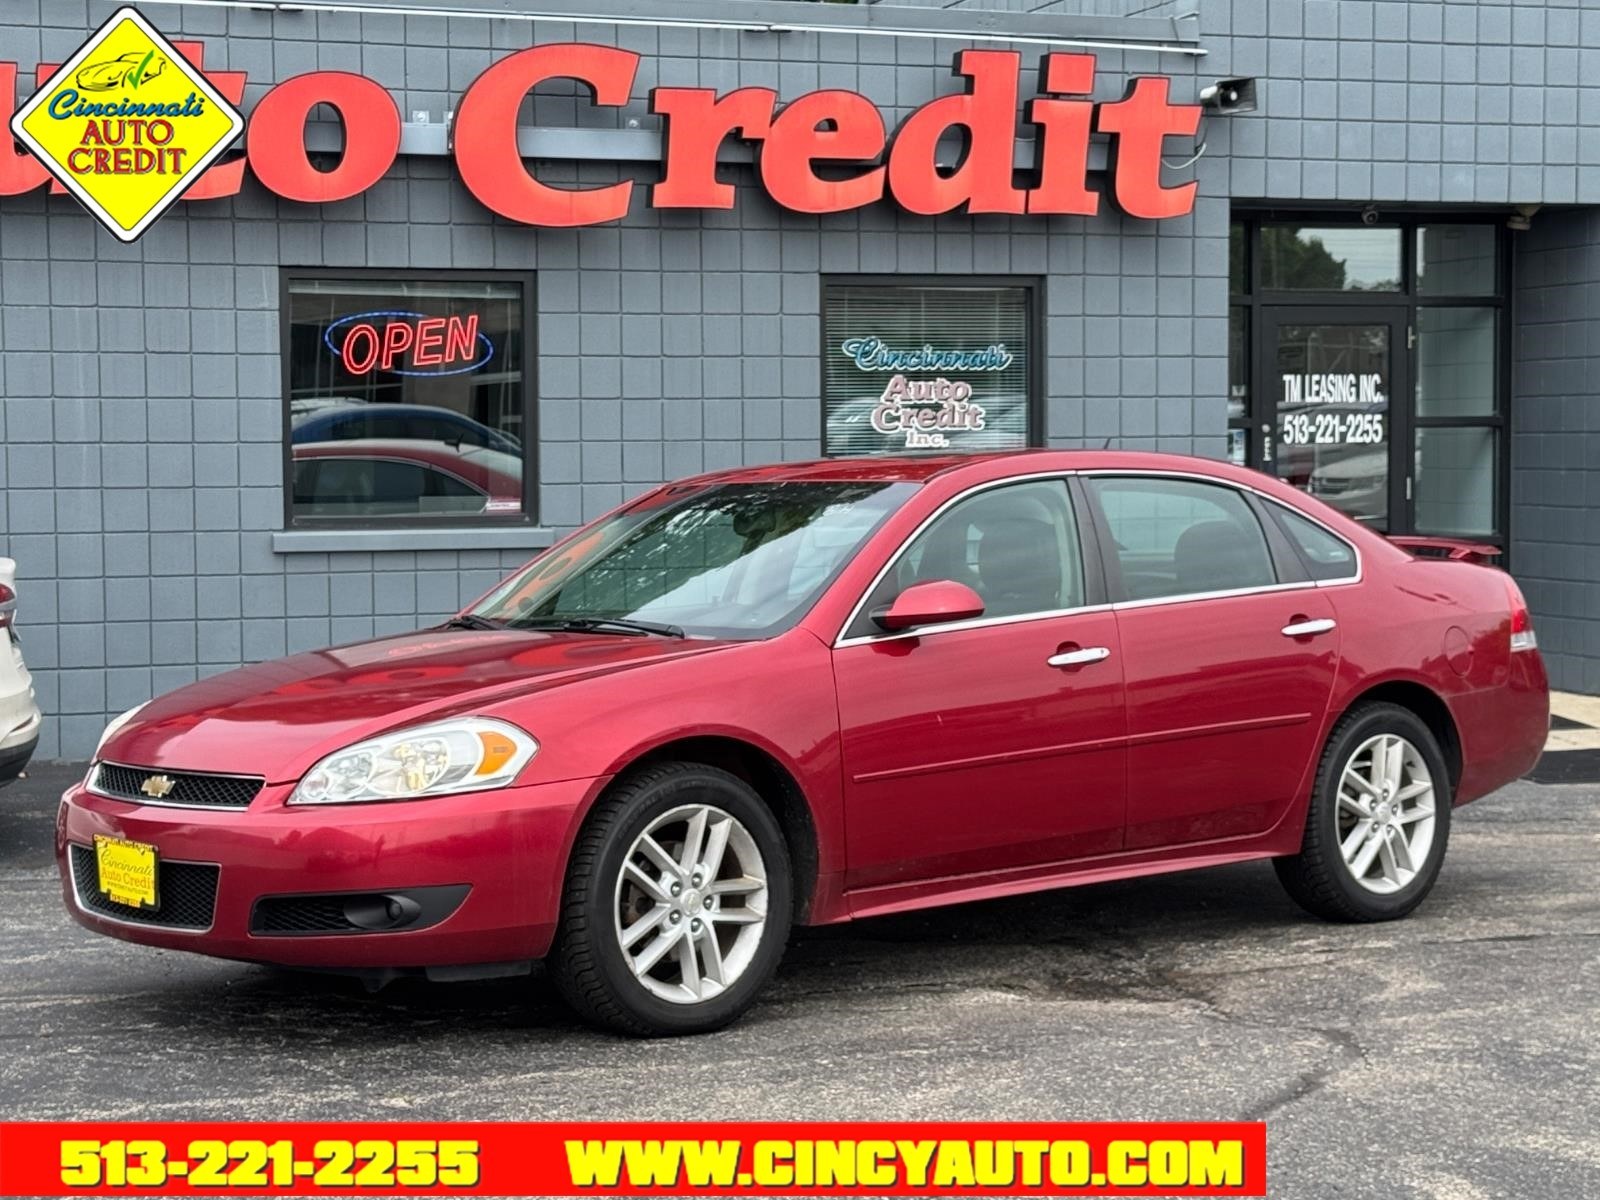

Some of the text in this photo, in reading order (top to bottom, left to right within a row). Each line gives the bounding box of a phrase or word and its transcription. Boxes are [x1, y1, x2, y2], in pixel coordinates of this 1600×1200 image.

[452, 42, 1203, 226] Credit
[342, 314, 479, 375] OPEN
[842, 336, 1013, 371] Cincinnati
[881, 374, 972, 404] Auto
[1282, 373, 1385, 403] TM LEASING INC.
[871, 403, 986, 434] Credit
[1282, 413, 1384, 444] 513-221-2255
[905, 431, 949, 448] Inc.
